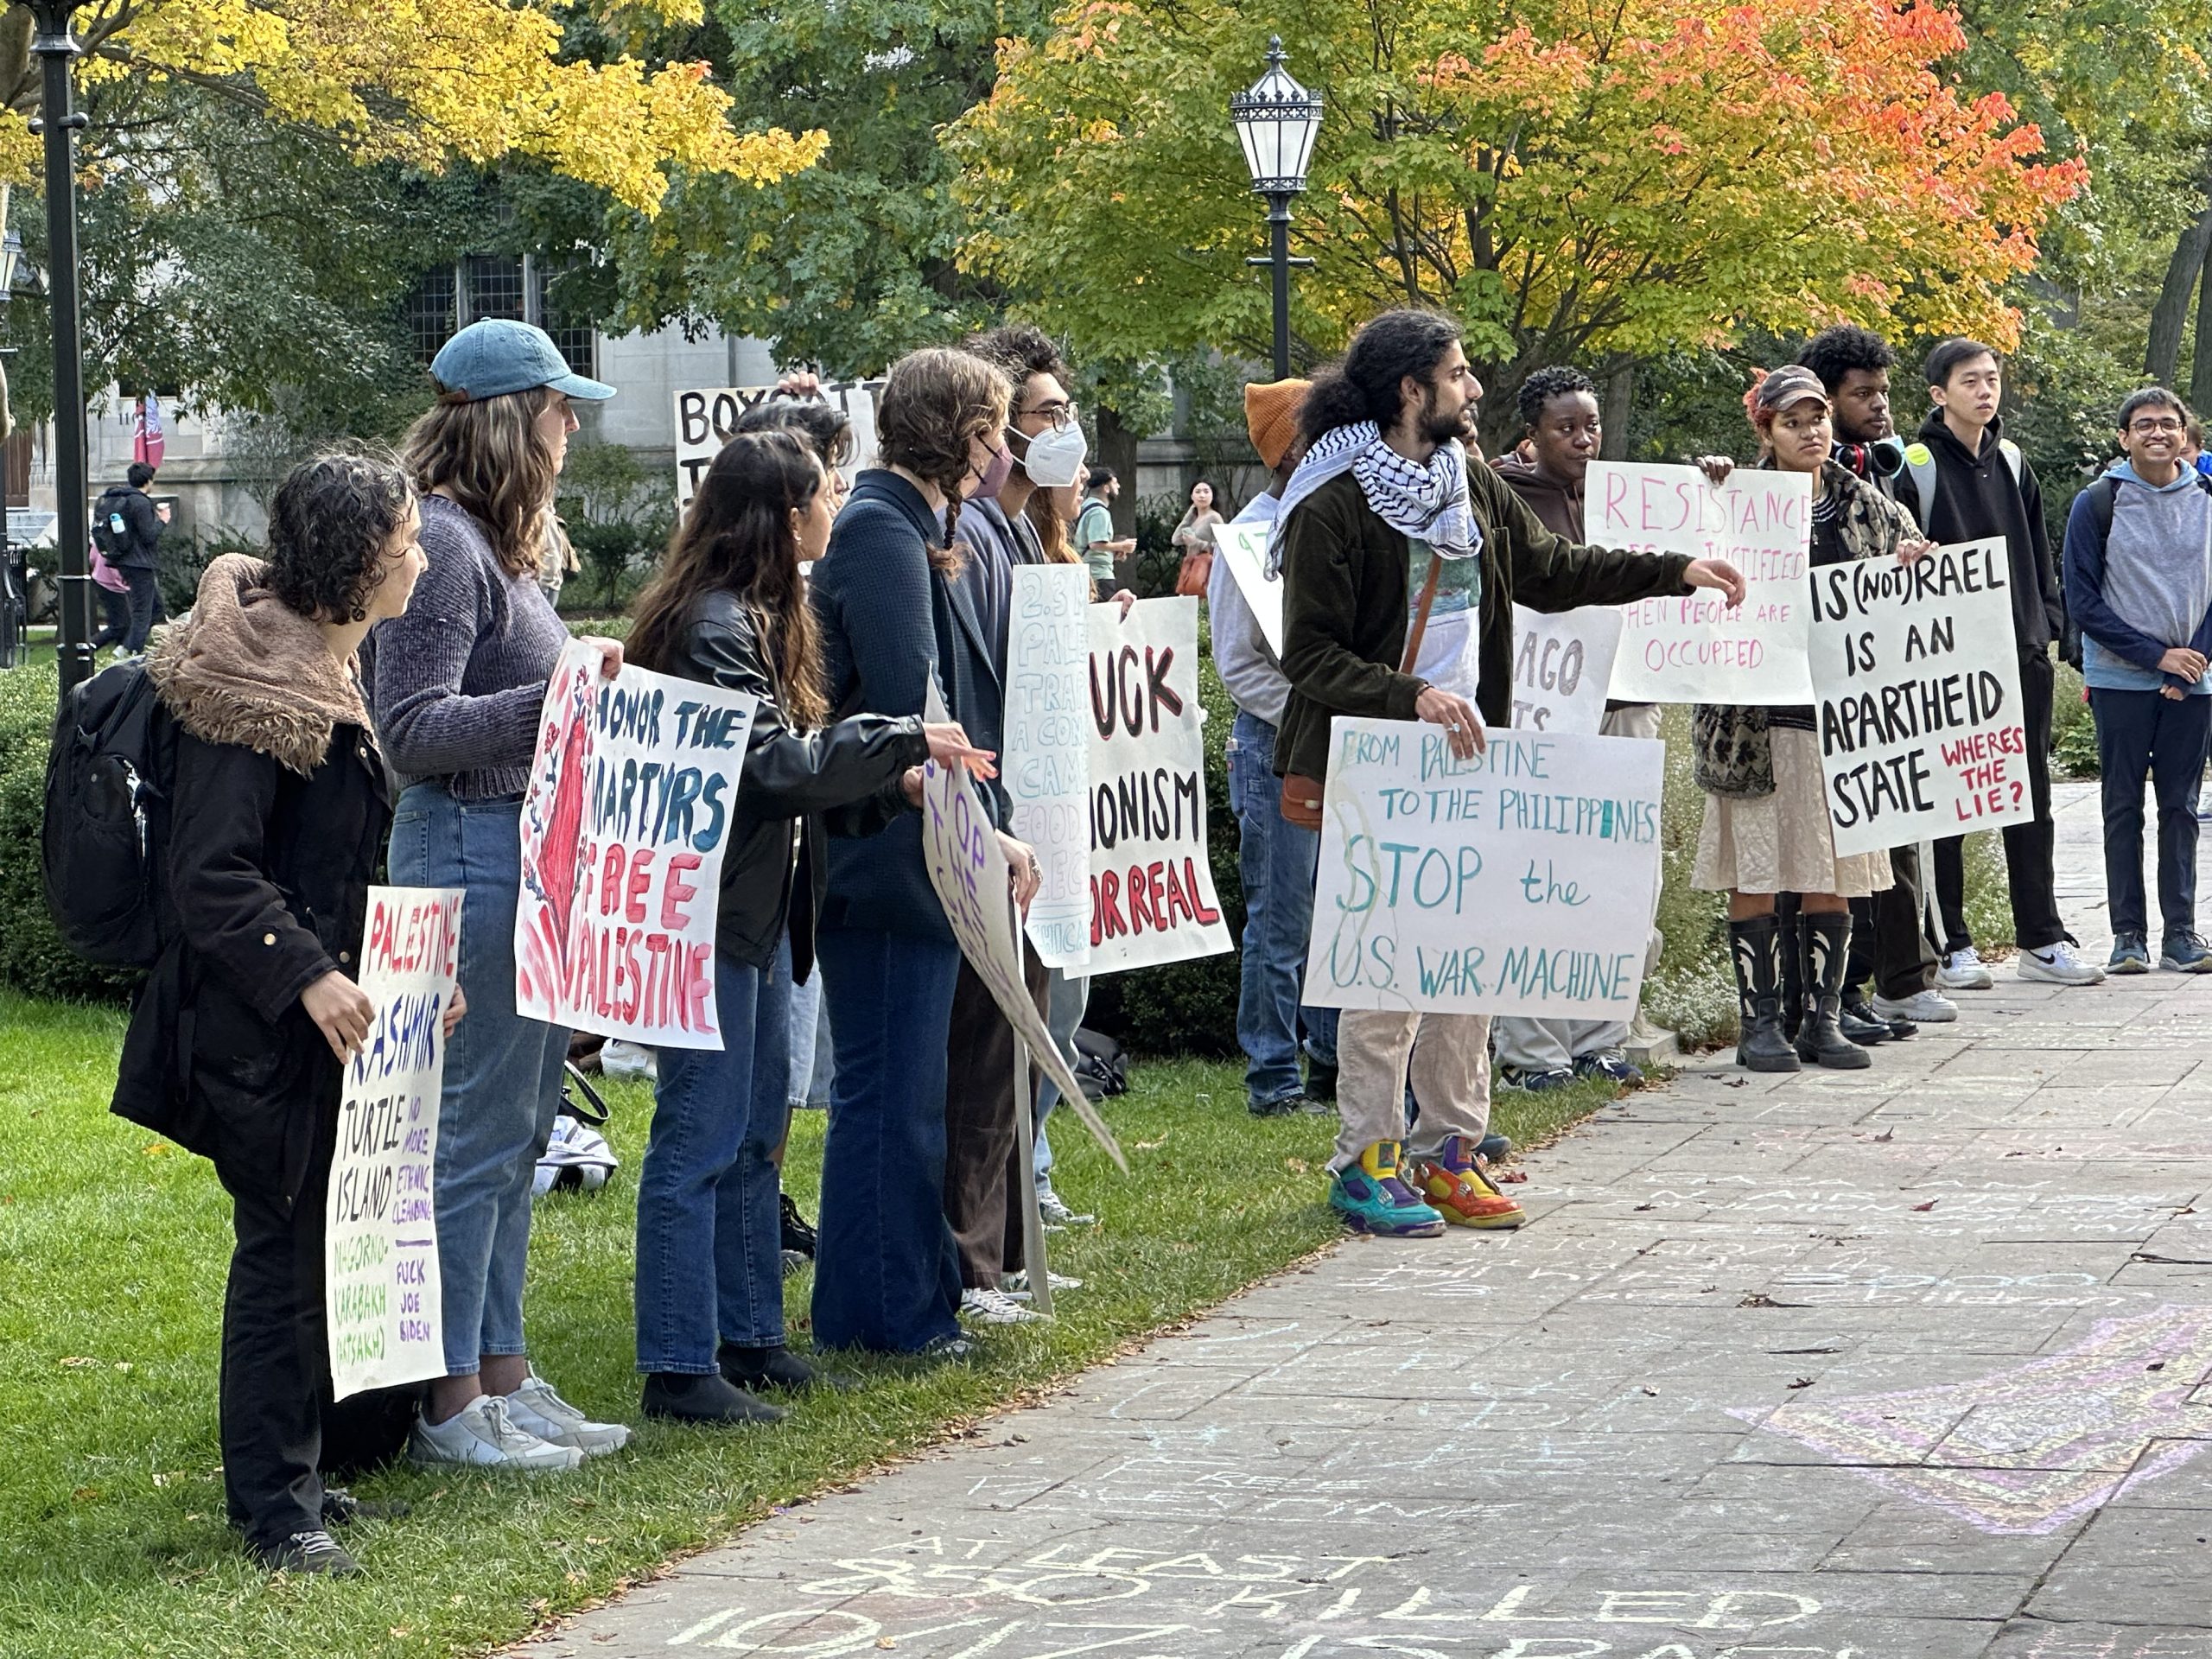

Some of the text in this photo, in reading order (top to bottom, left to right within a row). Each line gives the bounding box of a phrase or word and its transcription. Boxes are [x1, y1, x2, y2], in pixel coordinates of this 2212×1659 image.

[680, 381, 888, 446] BOYTT
[1605, 472, 1810, 544] RESISTANCE
[1624, 598, 1791, 629] HEN PEOPLE ARE
[1018, 622, 1087, 668] PALE
[1513, 630, 1585, 697] AGO
[1645, 639, 1764, 672] OCCUPIED
[1845, 616, 1955, 677] IS AN
[594, 686, 747, 751] HONOR THE
[1090, 645, 1183, 741] UCK
[1822, 671, 2005, 757] APARTHEID
[1012, 721, 1030, 752] A
[1342, 730, 1555, 782] FROM PALESTINE
[1941, 725, 2025, 768] WHERES
[590, 758, 728, 853] MARTYRS
[1379, 788, 1420, 820] TO
[1426, 787, 1483, 823] THE
[1833, 748, 1935, 829] STATE
[1955, 780, 2025, 823] LIE?
[1959, 758, 2007, 791] THE
[1090, 768, 1199, 854] IONISM
[584, 842, 703, 931] FREE
[1090, 869, 1128, 948] OR
[1128, 856, 1220, 936] REAL
[1336, 834, 1591, 915] STOP the
[367, 895, 460, 978] PALESTINE
[1330, 931, 1636, 1002] U.S. WAR MACHINE
[573, 918, 717, 1035] PALESTINE
[343, 1094, 405, 1161] TURTLE
[408, 1096, 421, 1122] NO
[402, 1127, 429, 1155] MORE
[336, 1163, 392, 1226] ISLAND
[396, 1257, 425, 1287] FUCK
[400, 1292, 420, 1314] JOE
[399, 1319, 431, 1343] BIDEN
[1021, 1542, 1416, 1580] LEAST
[1199, 1584, 1823, 1630] KILLED
